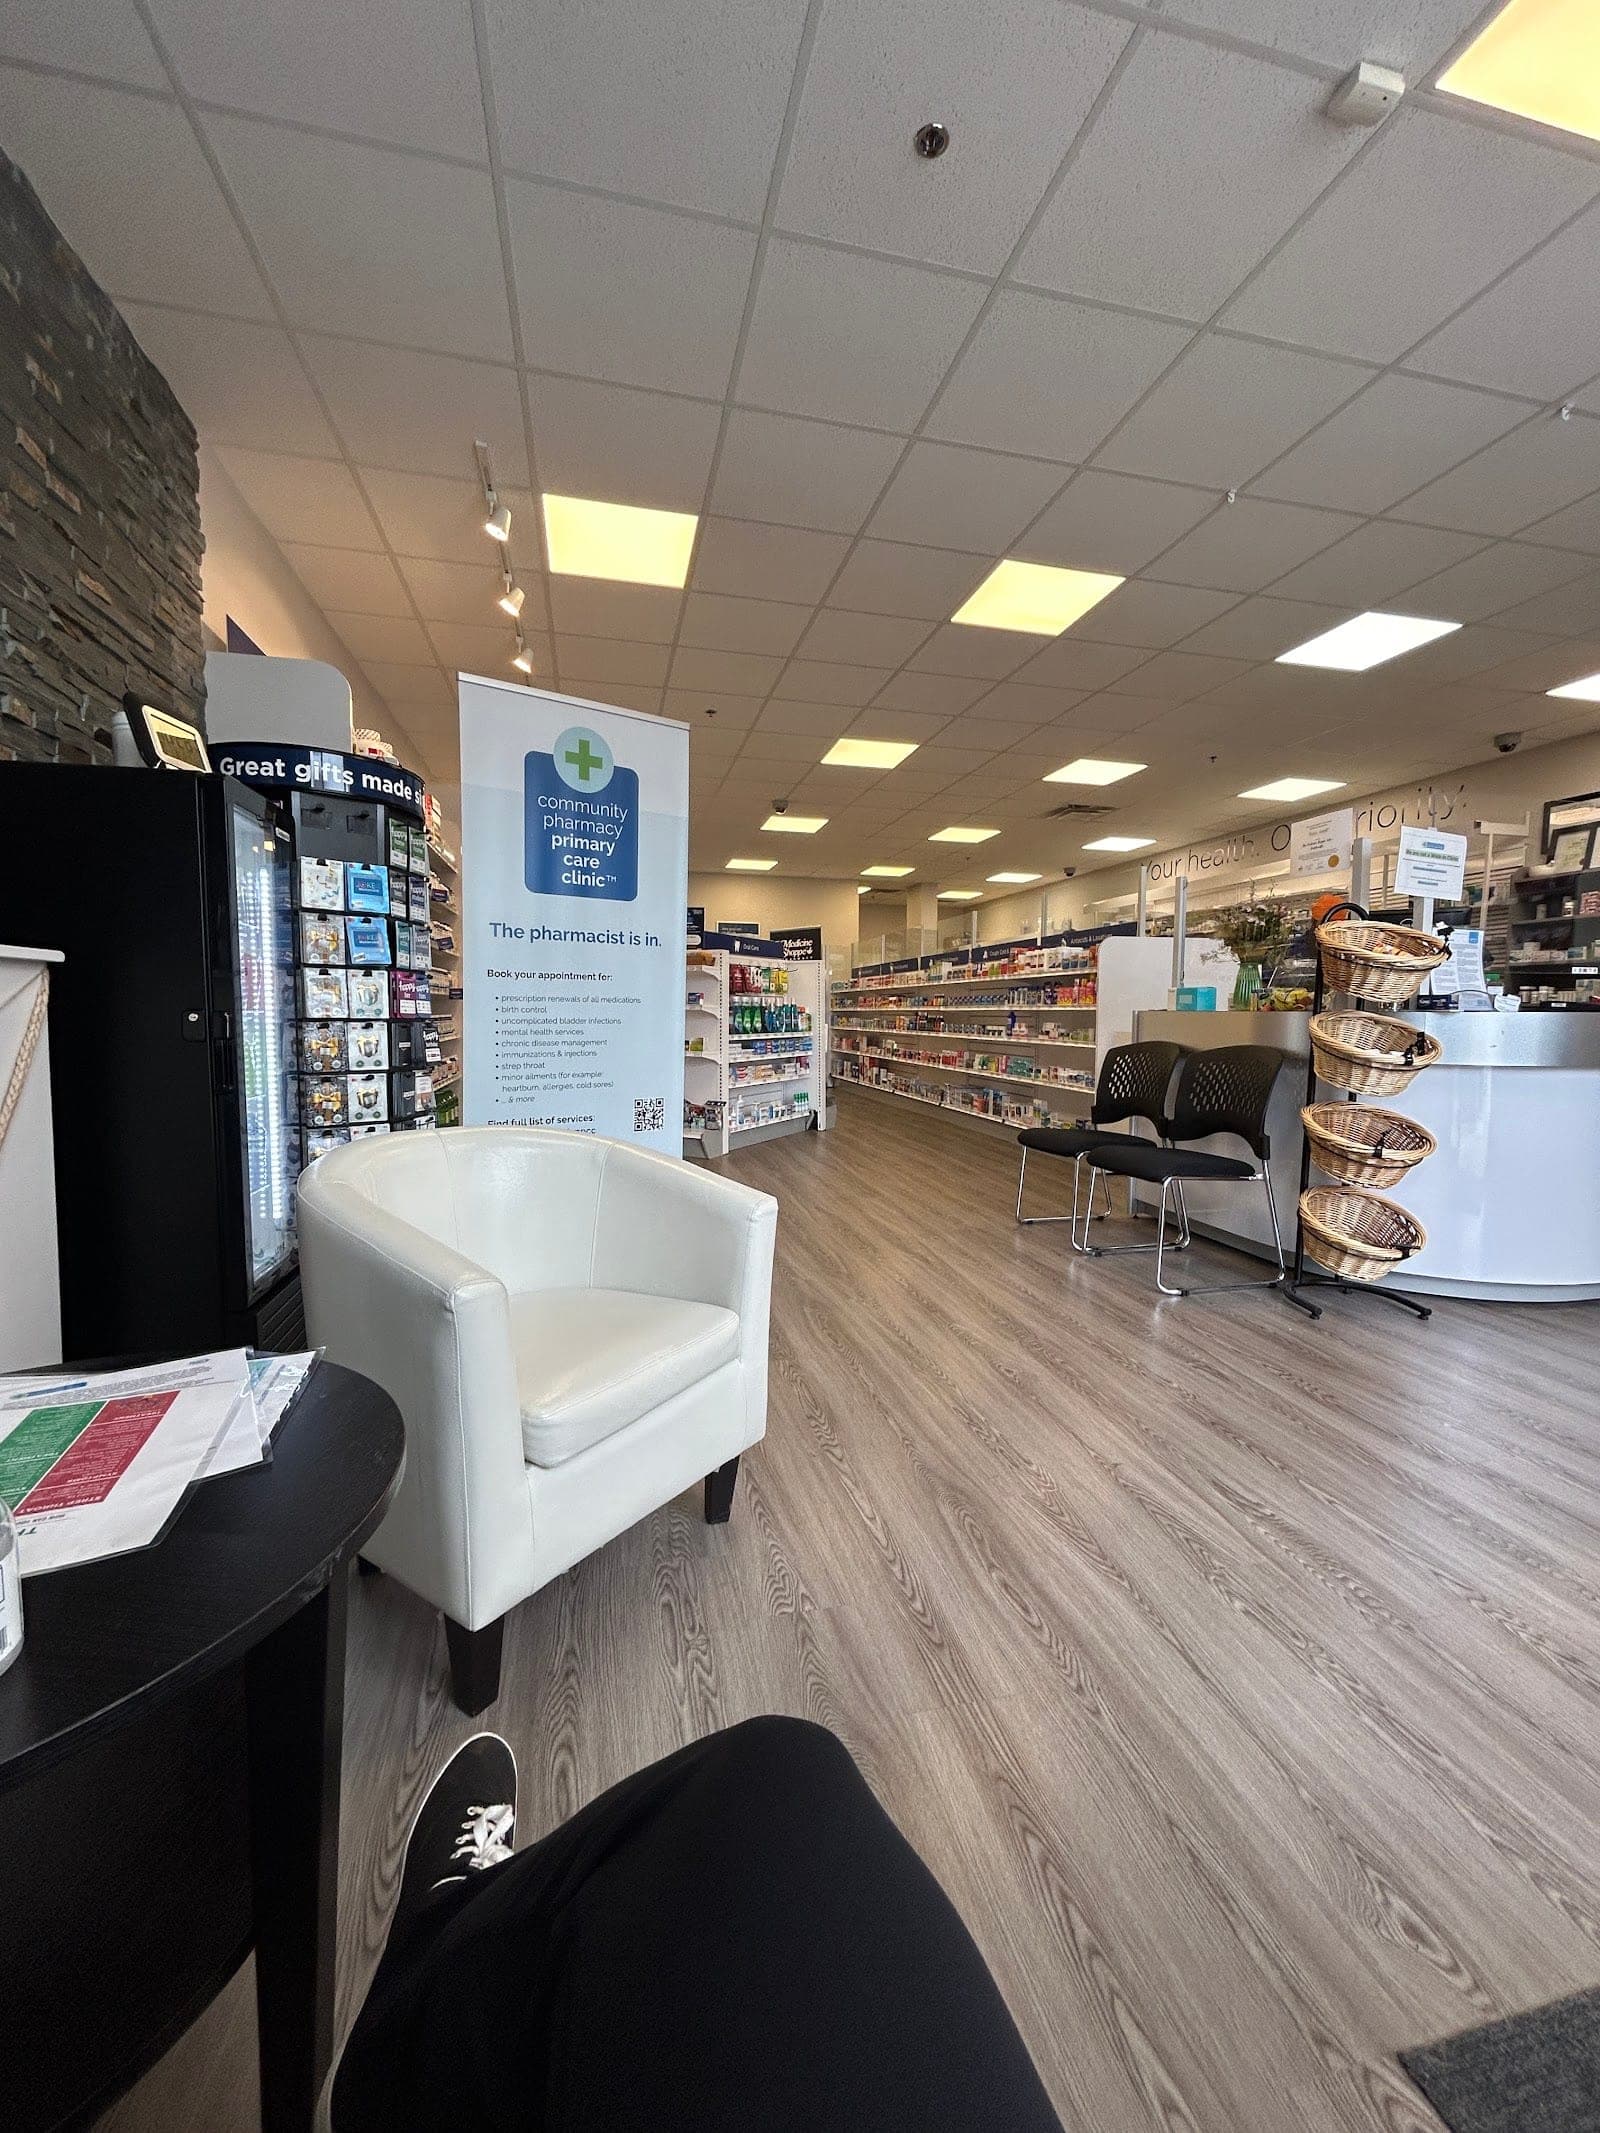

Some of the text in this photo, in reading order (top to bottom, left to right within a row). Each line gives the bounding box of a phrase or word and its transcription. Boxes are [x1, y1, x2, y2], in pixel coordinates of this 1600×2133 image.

[219, 757, 286, 777] Great
[294, 759, 354, 786] gifts
[362, 772, 412, 798] made
[537, 795, 628, 823] community
[543, 813, 623, 839] pharmacy
[551, 834, 616, 856] primary
[563, 854, 600, 869] care
[489, 922, 662, 947] The pharmacist is in.
[783, 938, 813, 948] Medicine
[487, 969, 613, 981] Book your appointment for:
[501, 995, 546, 1003] prescription
[582, 995, 590, 1003] of
[600, 996, 641, 1004] medications
[520, 1006, 547, 1014] control
[501, 1017, 558, 1025] uncomplicated
[588, 1017, 622, 1025] infections
[561, 1039, 608, 1048] management
[557, 1050, 563, 1058] &
[564, 1050, 598, 1058] injections
[501, 1063, 522, 1071] strep
[501, 1073, 524, 1081] minor
[576, 1081, 592, 1089] cold
[508, 1096, 514, 1104] &
[511, 1118, 527, 1126] full
[529, 1117, 543, 1126] list
[545, 1116, 556, 1125] of
[19, 1495, 102, 1513] STREP THROAT
